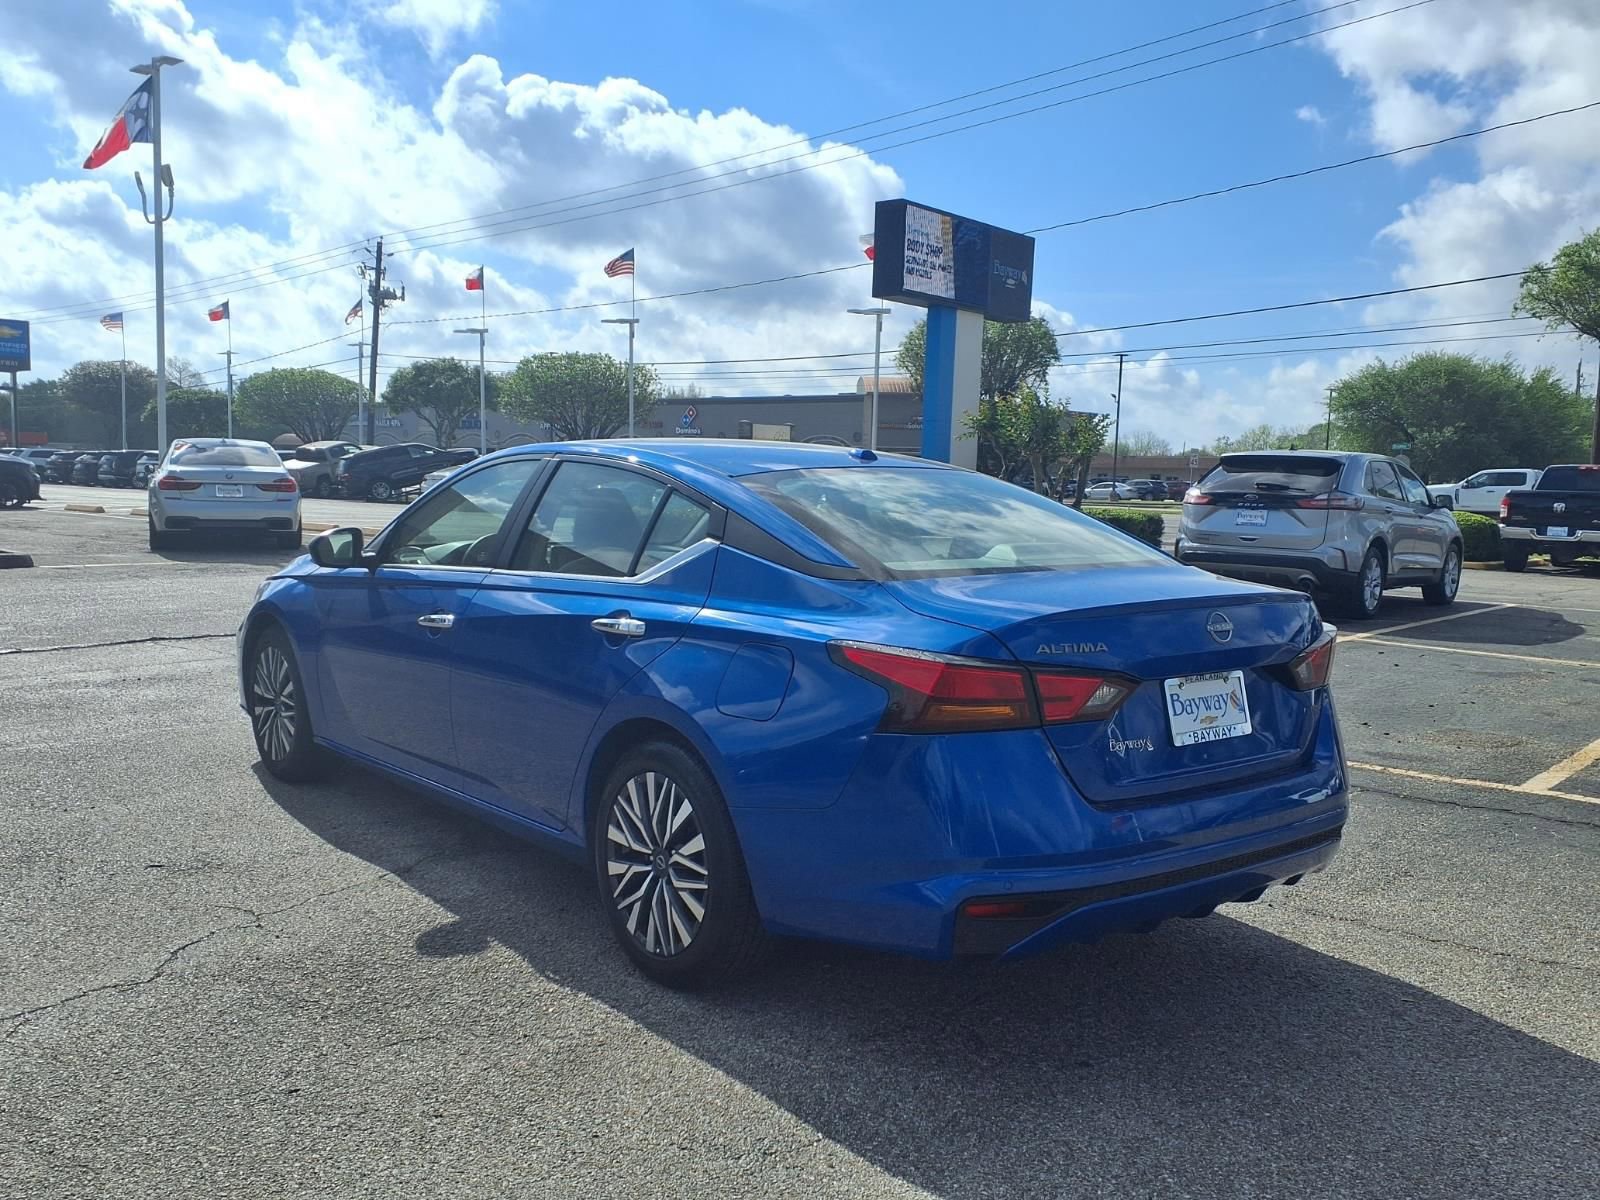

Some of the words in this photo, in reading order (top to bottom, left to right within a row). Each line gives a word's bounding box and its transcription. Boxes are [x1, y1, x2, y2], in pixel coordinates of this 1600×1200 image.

[926, 243, 944, 260] SHOP
[675, 426, 701, 435] Domino's
[1036, 642, 1108, 654] ALTIMA
[1170, 692, 1229, 722] Bayway
[1193, 725, 1232, 743] BAYWAY
[1109, 739, 1146, 753] Bayway
